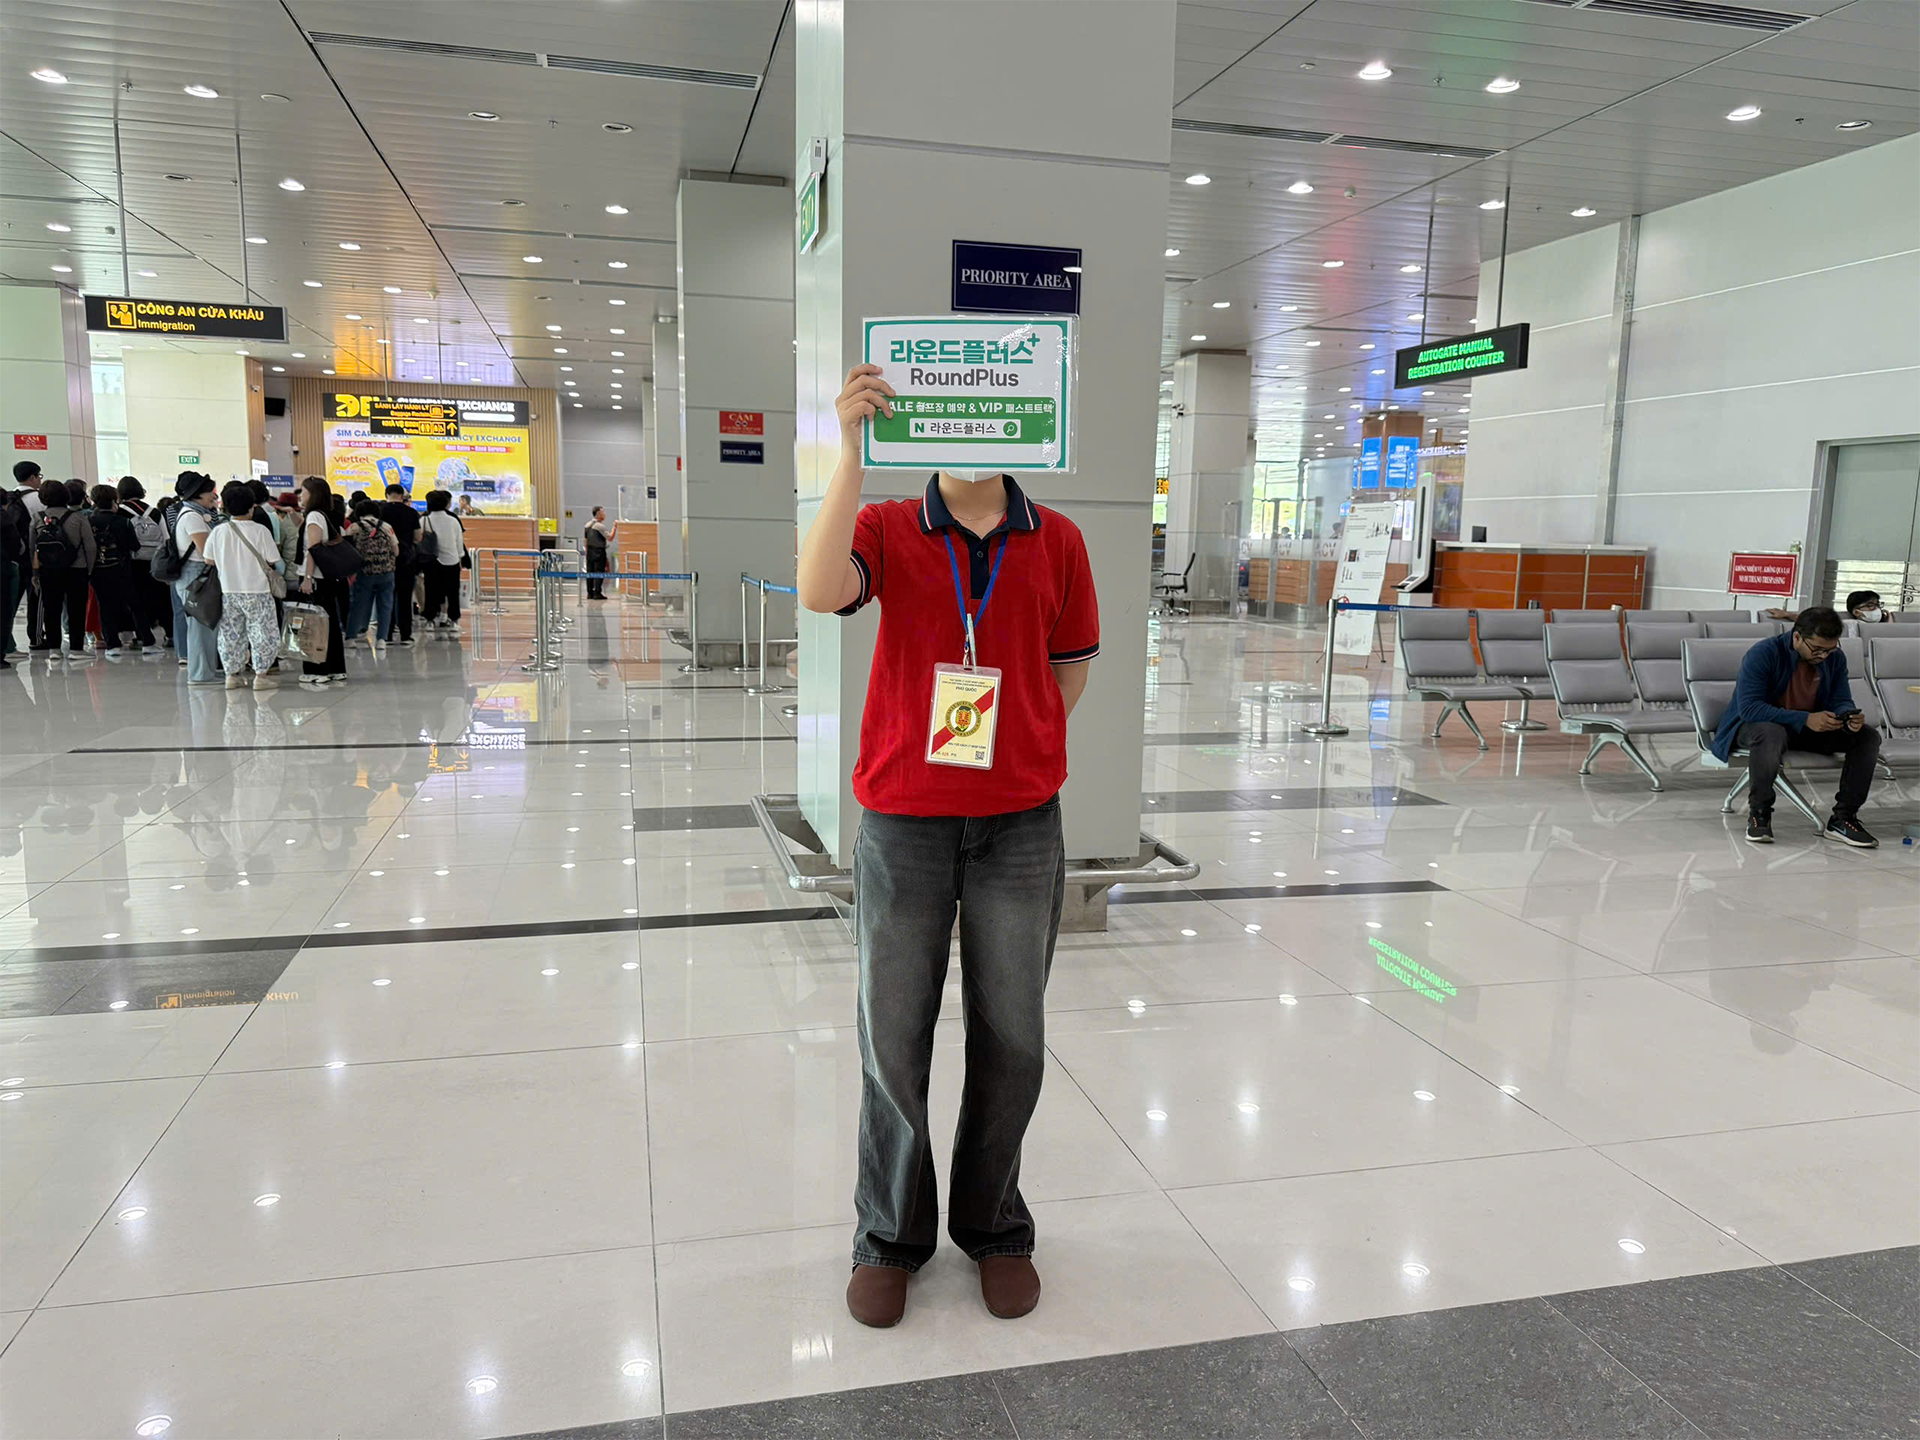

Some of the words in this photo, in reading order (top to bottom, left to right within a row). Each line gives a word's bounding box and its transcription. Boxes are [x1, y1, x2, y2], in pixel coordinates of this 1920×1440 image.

[961, 268, 1029, 285] PRIORITY
[1033, 273, 1072, 288] AREA
[137, 302, 175, 316] CÔNG
[178, 305, 196, 317] AN
[138, 319, 196, 332] Immigration
[1418, 344, 1458, 364] AUTOGATE
[1458, 337, 1494, 356] MANUAL
[1408, 358, 1464, 380] REGISTRATION
[1464, 350, 1505, 370] COUNTER
[910, 368, 1019, 387] RoundPlus
[458, 400, 515, 412] EXCHANGE
[947, 402, 966, 414] 예약
[968, 402, 976, 413] &
[978, 402, 1002, 413] VIP
[914, 422, 925, 433] N
[930, 422, 996, 435] 라운드플러스
[476, 434, 522, 444] EXCHANGE
[334, 456, 370, 464] viettel
[382, 460, 394, 469] 5G
